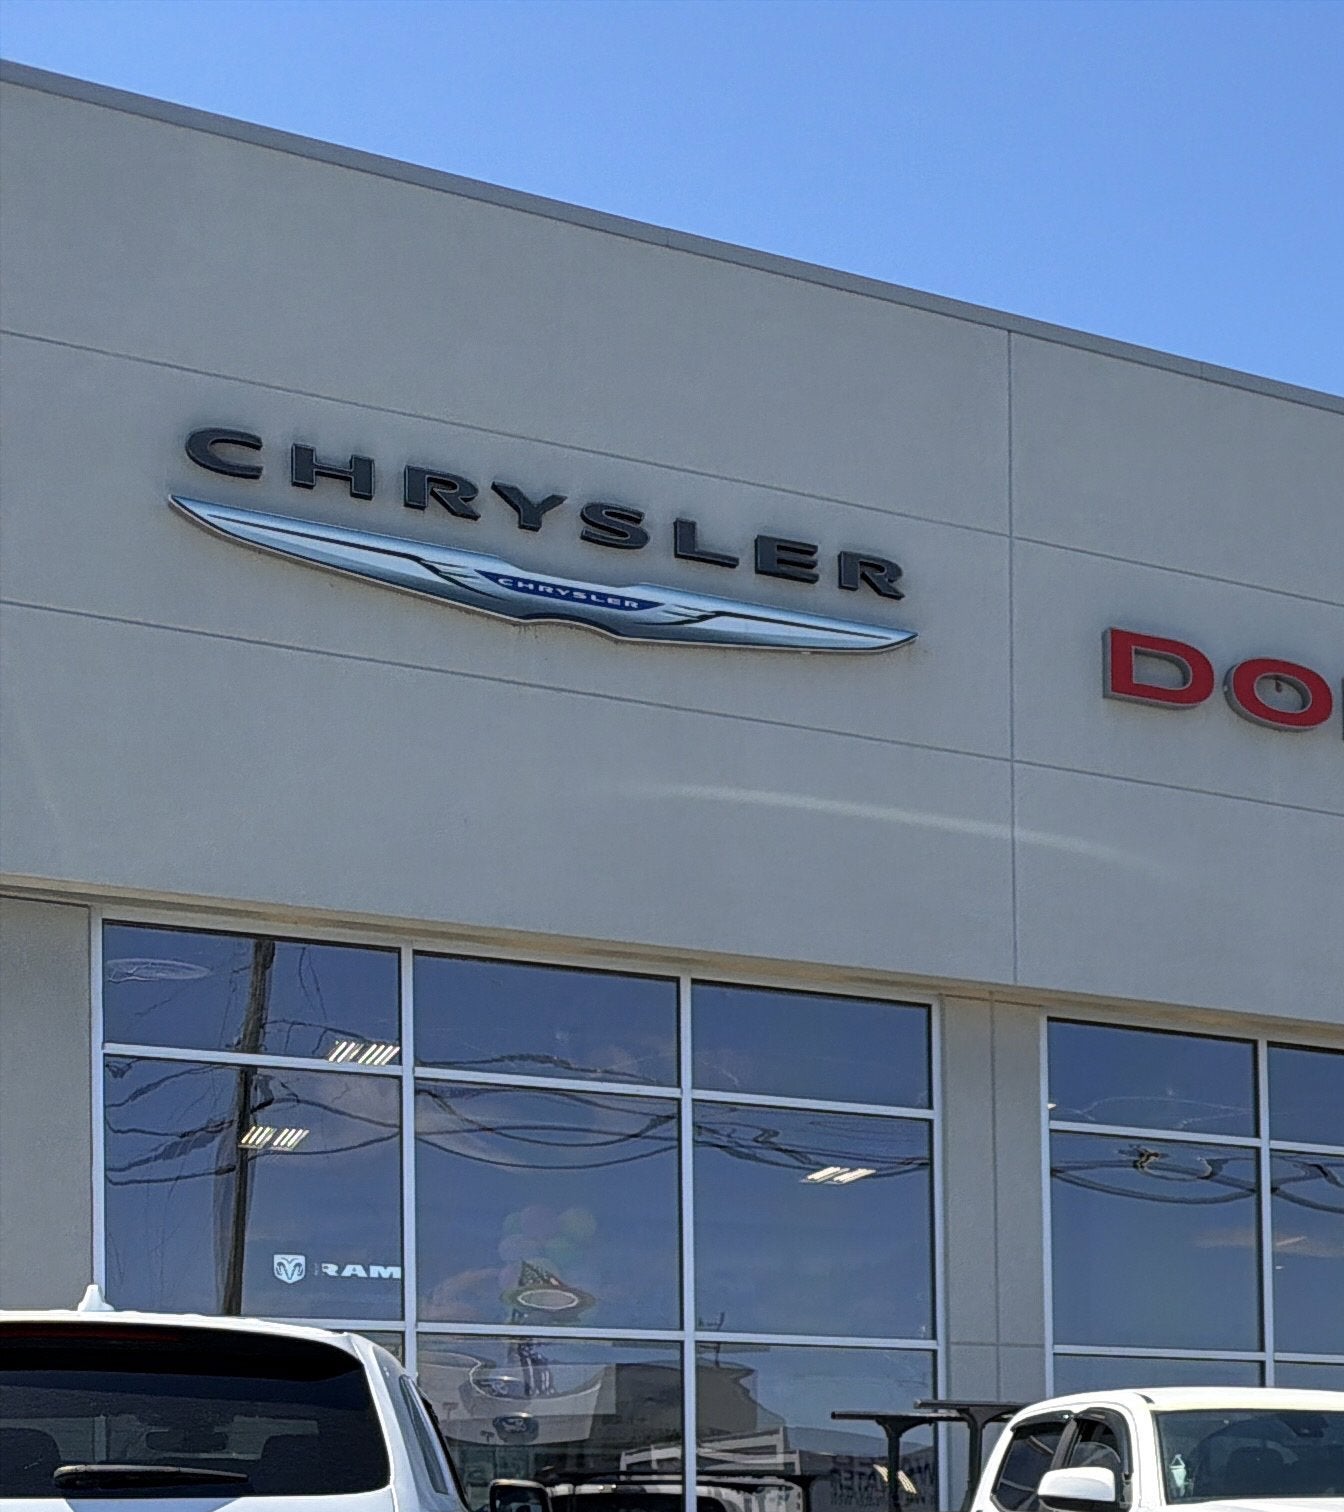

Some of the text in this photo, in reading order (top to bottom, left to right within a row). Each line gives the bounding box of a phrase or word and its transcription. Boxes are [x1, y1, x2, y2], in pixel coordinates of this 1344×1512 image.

[184, 427, 905, 599] CHRYSLER
[498, 578, 639, 608] CHRYSLER
[314, 1262, 402, 1280] RAM
